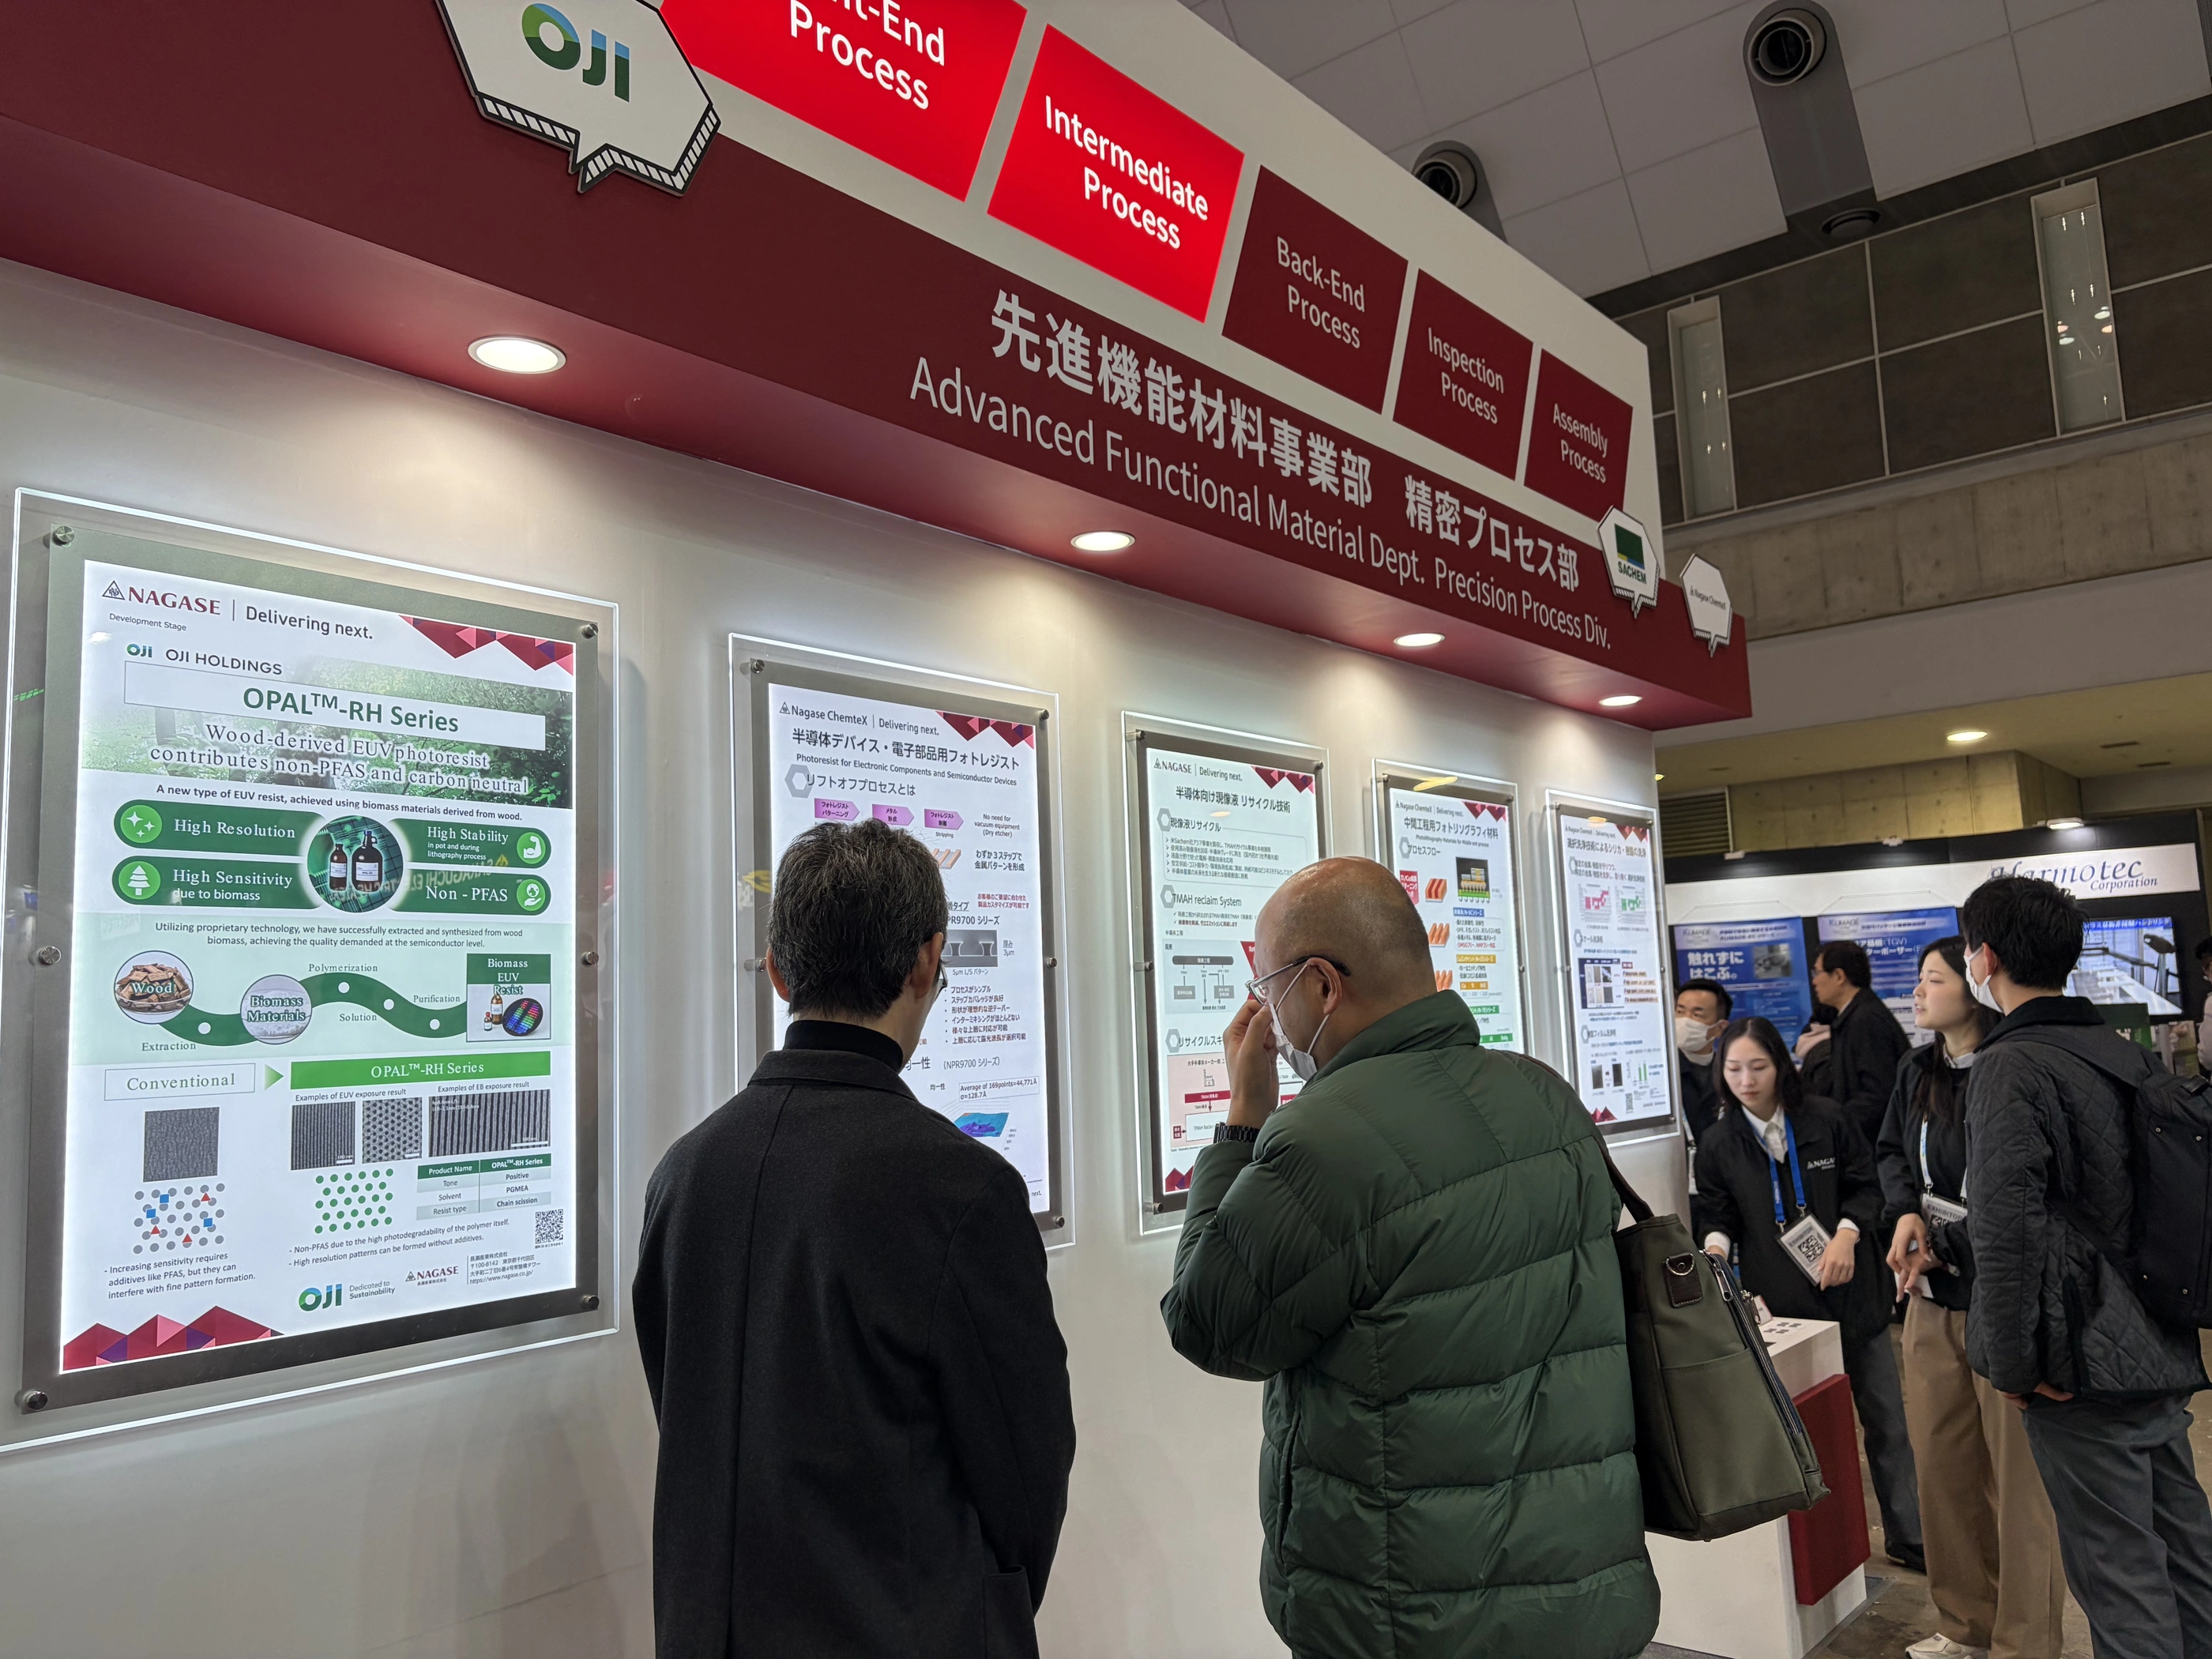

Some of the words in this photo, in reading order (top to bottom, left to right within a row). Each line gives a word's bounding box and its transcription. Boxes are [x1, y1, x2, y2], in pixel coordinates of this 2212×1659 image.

[521, 3, 630, 103] OJI
[790, 1, 929, 110] Process
[1045, 95, 1209, 221] Intermediate
[1084, 167, 1181, 249] Process
[1277, 236, 1365, 313] Back-End
[1288, 284, 1360, 348] Process
[1428, 327, 1504, 393] Inspection
[1441, 371, 1498, 424] Process
[991, 288, 1373, 508] 先進機能材料事業部
[1404, 475, 1579, 592] 精密プロセス部
[1553, 403, 1608, 458] Assembly
[1560, 439, 1607, 483] Process
[910, 356, 1095, 465] Advanced
[1106, 430, 1261, 526] Functional
[1268, 493, 1365, 563] Material
[1370, 532, 1425, 586] Dept.
[1435, 557, 1518, 616] Precision
[1522, 589, 1582, 639] Process
[1584, 613, 1612, 650] Div.
[1618, 561, 1647, 585] SACHEM
[128, 587, 220, 615] NAGASE
[109, 612, 162, 627] Development
[164, 621, 186, 631] Stage
[246, 606, 329, 635] Delivering
[335, 623, 373, 639] next.
[126, 643, 153, 658] OJI
[166, 649, 190, 664] OJI
[195, 653, 283, 675] HOLDINGS
[390, 705, 458, 732] Series
[792, 705, 826, 720] Nagase
[827, 710, 868, 726] ChemteX
[878, 717, 919, 735] Delivering
[920, 725, 939, 735] next.
[205, 724, 345, 753] Wood-derived
[352, 739, 392, 758] EUV
[395, 744, 489, 769] photoresist
[792, 728, 1020, 771] 半導体デバイス・電子部品用フォトレジスト
[150, 747, 269, 770] contributes
[276, 758, 366, 779] non-PFAS
[371, 767, 402, 782] and
[409, 770, 466, 788] carbon
[472, 777, 529, 793] neutral
[796, 753, 839, 766] Photoresist
[841, 758, 852, 766] for
[853, 759, 888, 771] Electronic
[890, 764, 931, 776] Components
[946, 770, 992, 782] Semiconductor
[994, 776, 1017, 785] Devices
[1161, 759, 1192, 773] NAGASE
[1199, 766, 1228, 781] Delivering
[1228, 772, 1243, 781] next.
[807, 774, 916, 796] リフトオフプロセスとは
[1176, 785, 1240, 807] 半導体向け現像液
[1241, 795, 1291, 813] リサイクル技術
[1400, 802, 1414, 812] Nagase
[174, 818, 212, 836] High
[216, 822, 295, 838] Resolution
[982, 829, 993, 837] (Dry
[995, 830, 1013, 838] etcher)
[995, 822, 1021, 832] equipment
[1170, 817, 1221, 832] 現像液リサイクル
[427, 826, 457, 841] High
[461, 828, 509, 845] Stability
[1409, 845, 1441, 856] プロセスフロー
[974, 860, 1025, 871] 金属パターンを形成
[172, 869, 210, 885] High
[215, 871, 292, 889] Sensitivity
[2090, 876, 2158, 893] Corporation
[172, 889, 195, 899] due
[198, 890, 211, 899] to
[213, 889, 261, 901] biomass
[426, 886, 457, 900] Non
[471, 888, 508, 902] PFAS
[1172, 893, 1193, 905] TMAH
[1194, 895, 1218, 906] reclaim
[1220, 897, 1242, 908] System
[977, 916, 1000, 925] シリーズ
[308, 963, 378, 973] Polymerization
[487, 958, 528, 968] Biomass
[1687, 951, 1744, 966] 触れずに
[497, 972, 520, 982] EUV
[131, 981, 173, 994] Wood
[494, 985, 523, 995] Resist
[250, 996, 303, 1007] Biomass
[247, 1010, 306, 1021] Materials
[339, 1013, 378, 1021] Solution
[141, 1041, 196, 1051] Extraction
[447, 1061, 484, 1074] Series
[126, 1074, 235, 1091] Conventional
[960, 1083, 981, 1093] Average
[416, 1266, 459, 1281] NAGASE
[349, 1280, 382, 1292] Dedicated
[349, 1286, 396, 1300] Sustainability
[299, 1283, 342, 1312] OJI
